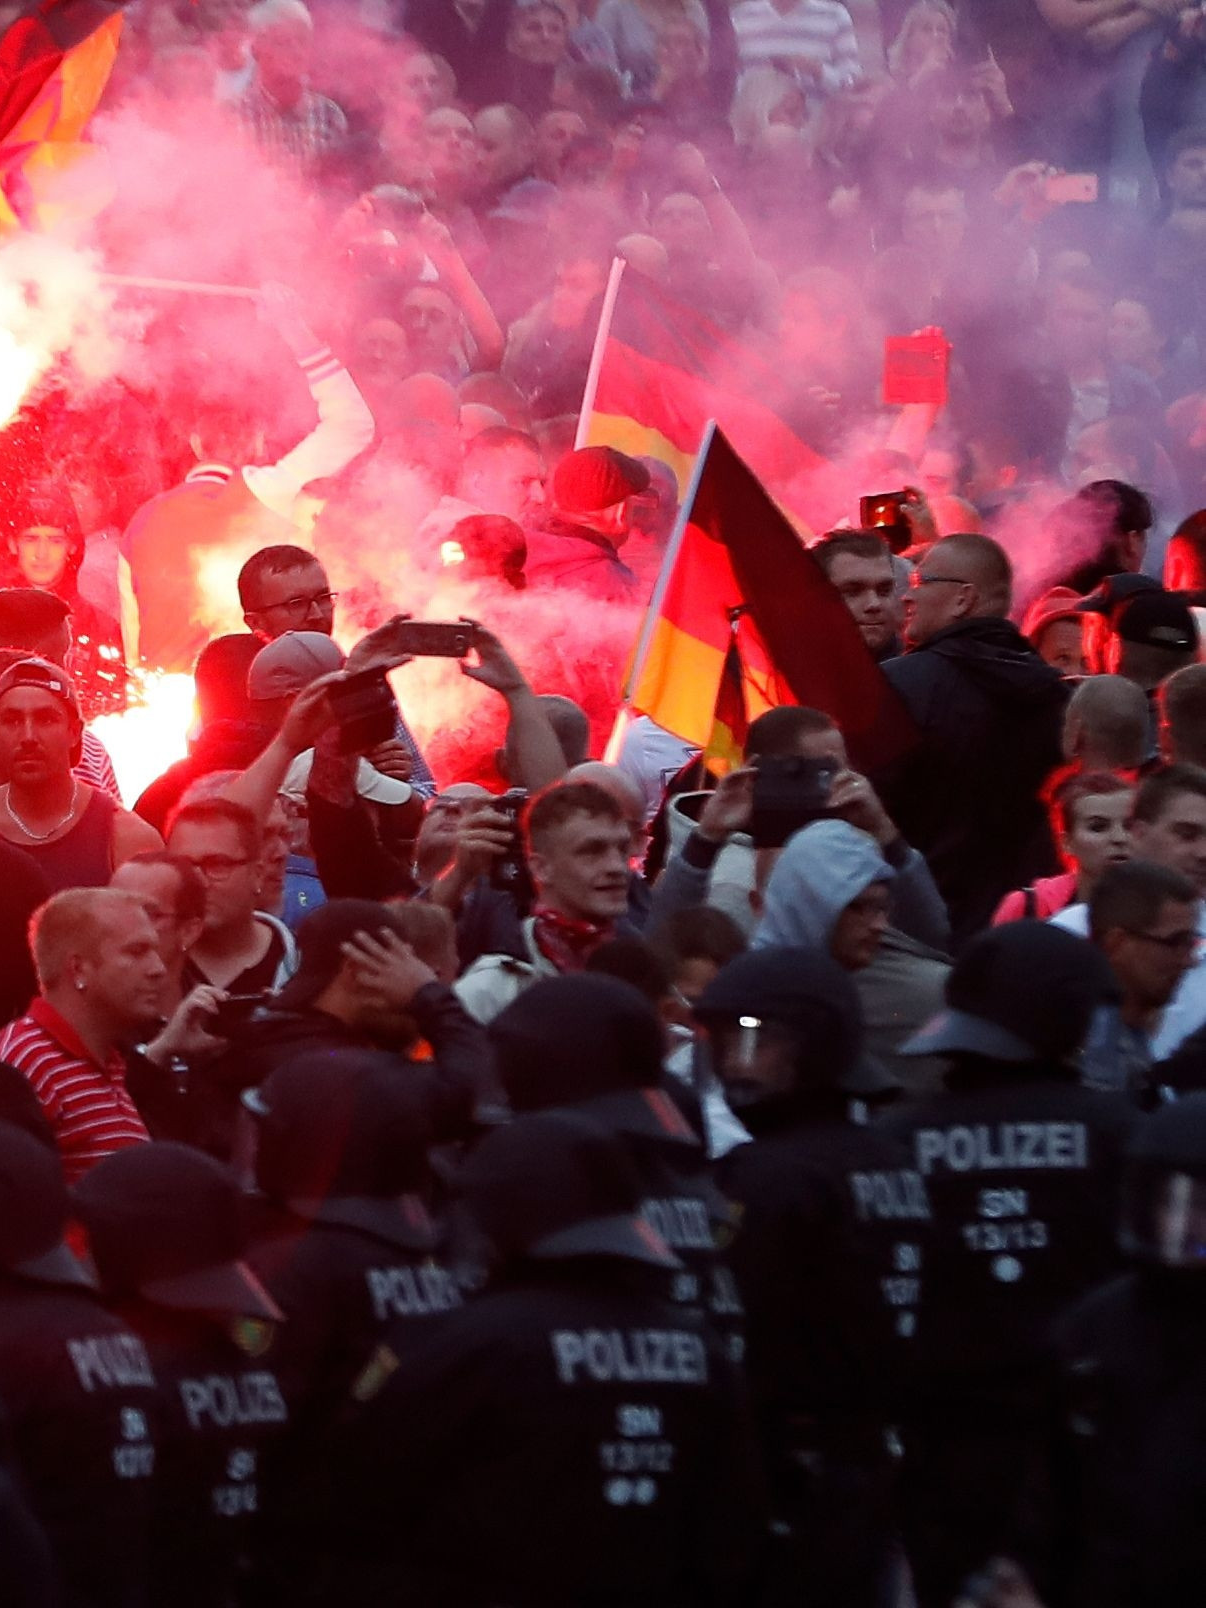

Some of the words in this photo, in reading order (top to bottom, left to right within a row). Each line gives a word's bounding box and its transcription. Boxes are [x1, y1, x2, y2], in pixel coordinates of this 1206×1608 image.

[914, 1120, 1088, 1175] POLIZEI
[978, 1187, 1030, 1219] SN
[550, 1327, 708, 1385] POLIZEI
